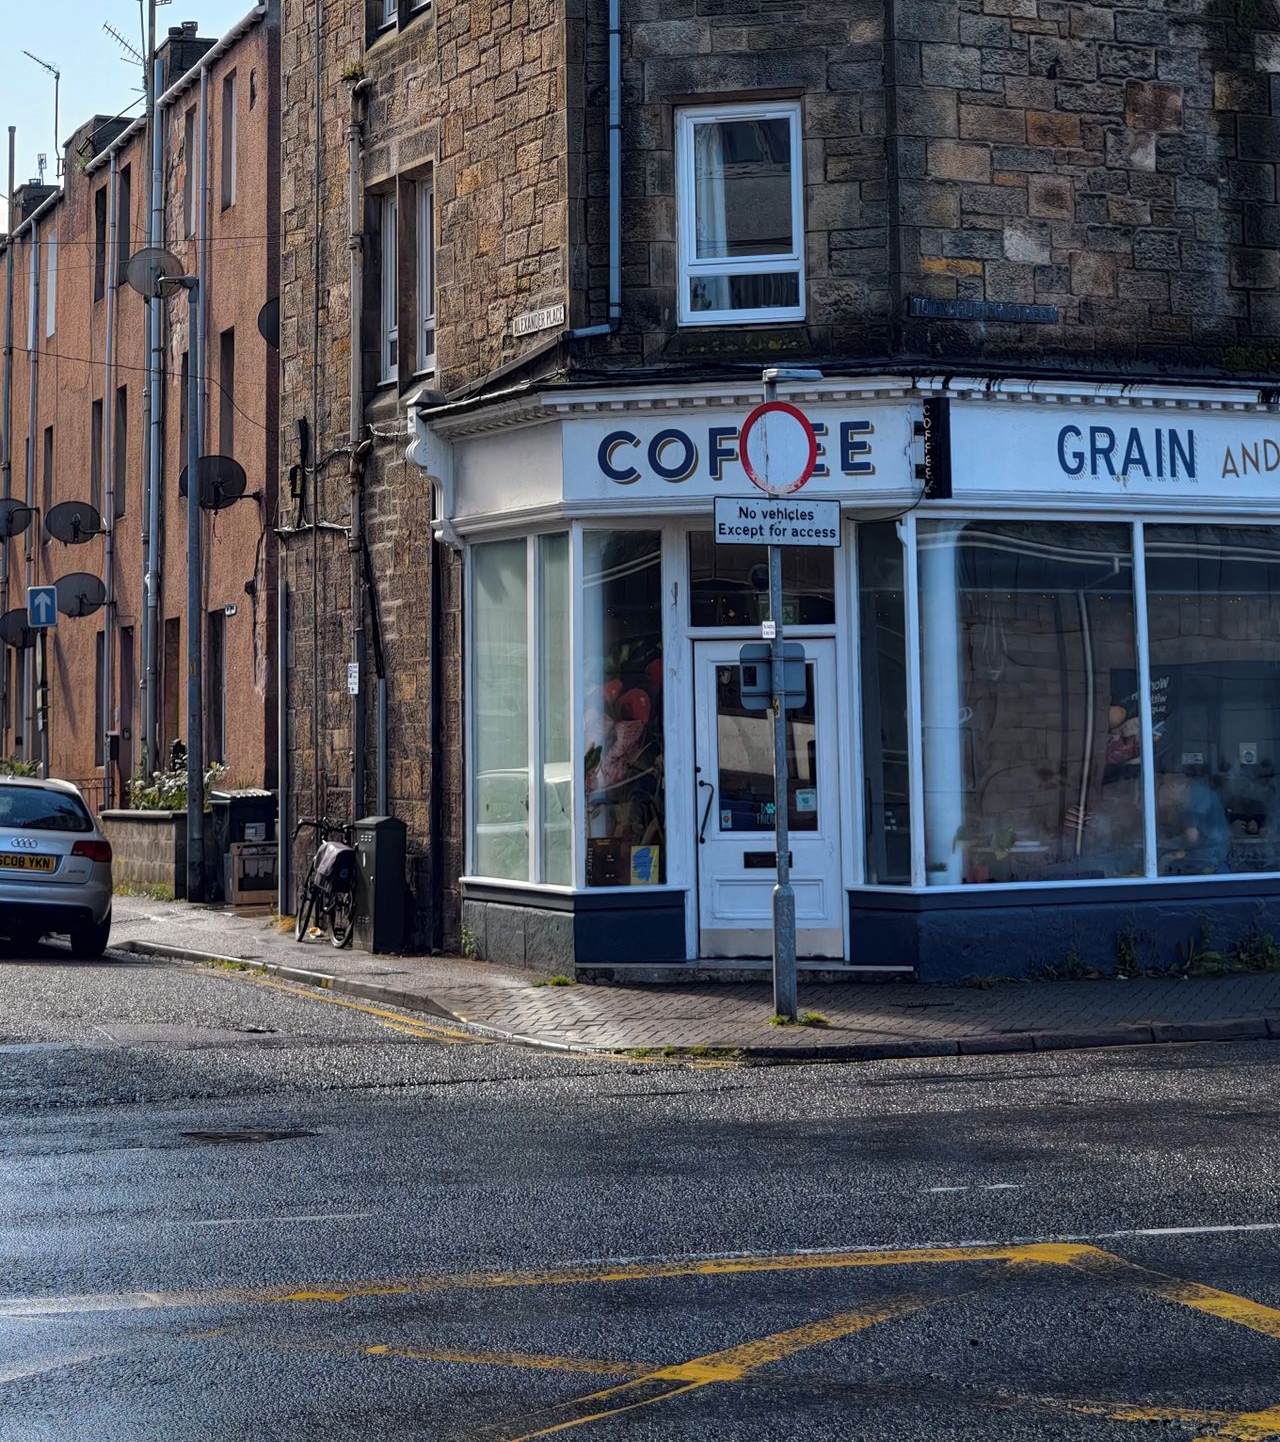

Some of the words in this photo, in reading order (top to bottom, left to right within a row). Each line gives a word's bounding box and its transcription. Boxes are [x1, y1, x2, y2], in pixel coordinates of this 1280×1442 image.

[598, 421, 874, 484] COFEE
[1057, 424, 1199, 482] GRAIN
[1221, 438, 1280, 478] AND
[739, 506, 756, 519] No
[761, 508, 814, 520] vehicles
[718, 523, 764, 538] Except
[769, 524, 787, 537] for
[791, 528, 836, 538] access
[26, 856, 50, 869] YKN
